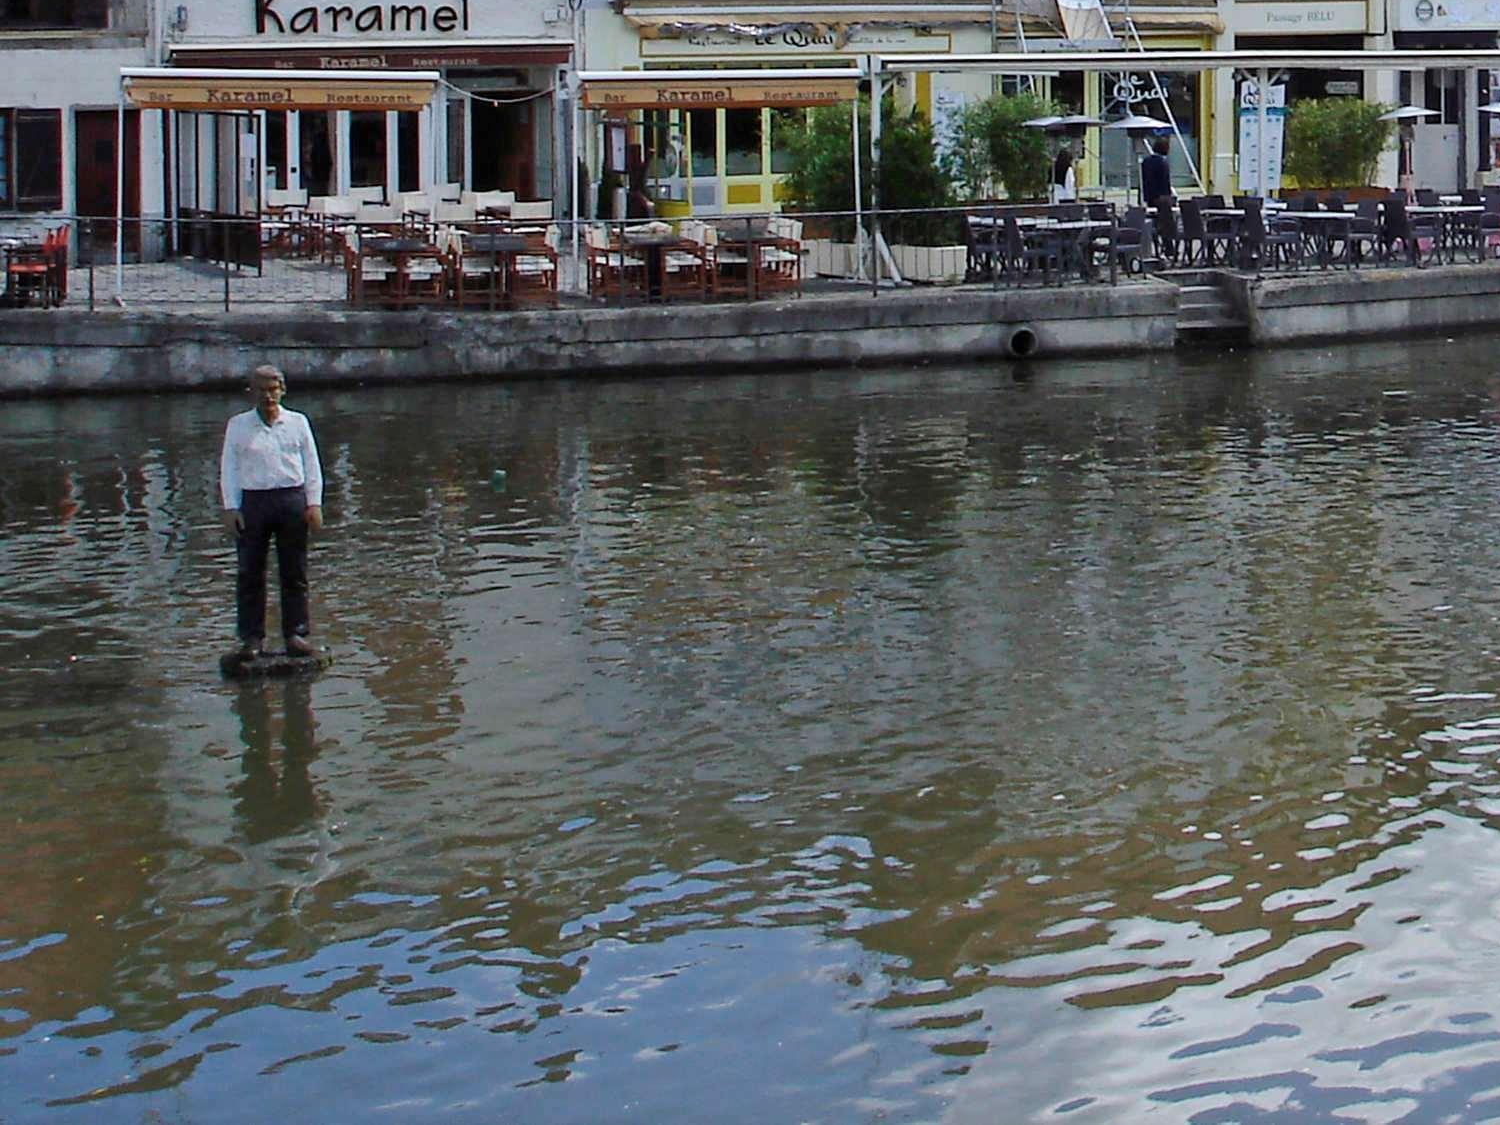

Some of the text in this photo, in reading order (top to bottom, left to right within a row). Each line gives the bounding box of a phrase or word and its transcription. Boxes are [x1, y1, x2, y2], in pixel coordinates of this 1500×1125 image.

[320, 56, 389, 69] Karamel
[413, 58, 479, 66] Restaurant
[150, 88, 414, 102] Bar Karamel Restaurant
[604, 87, 840, 102] Bar Karamel Restaurant
[1113, 82, 1168, 103] Quai
